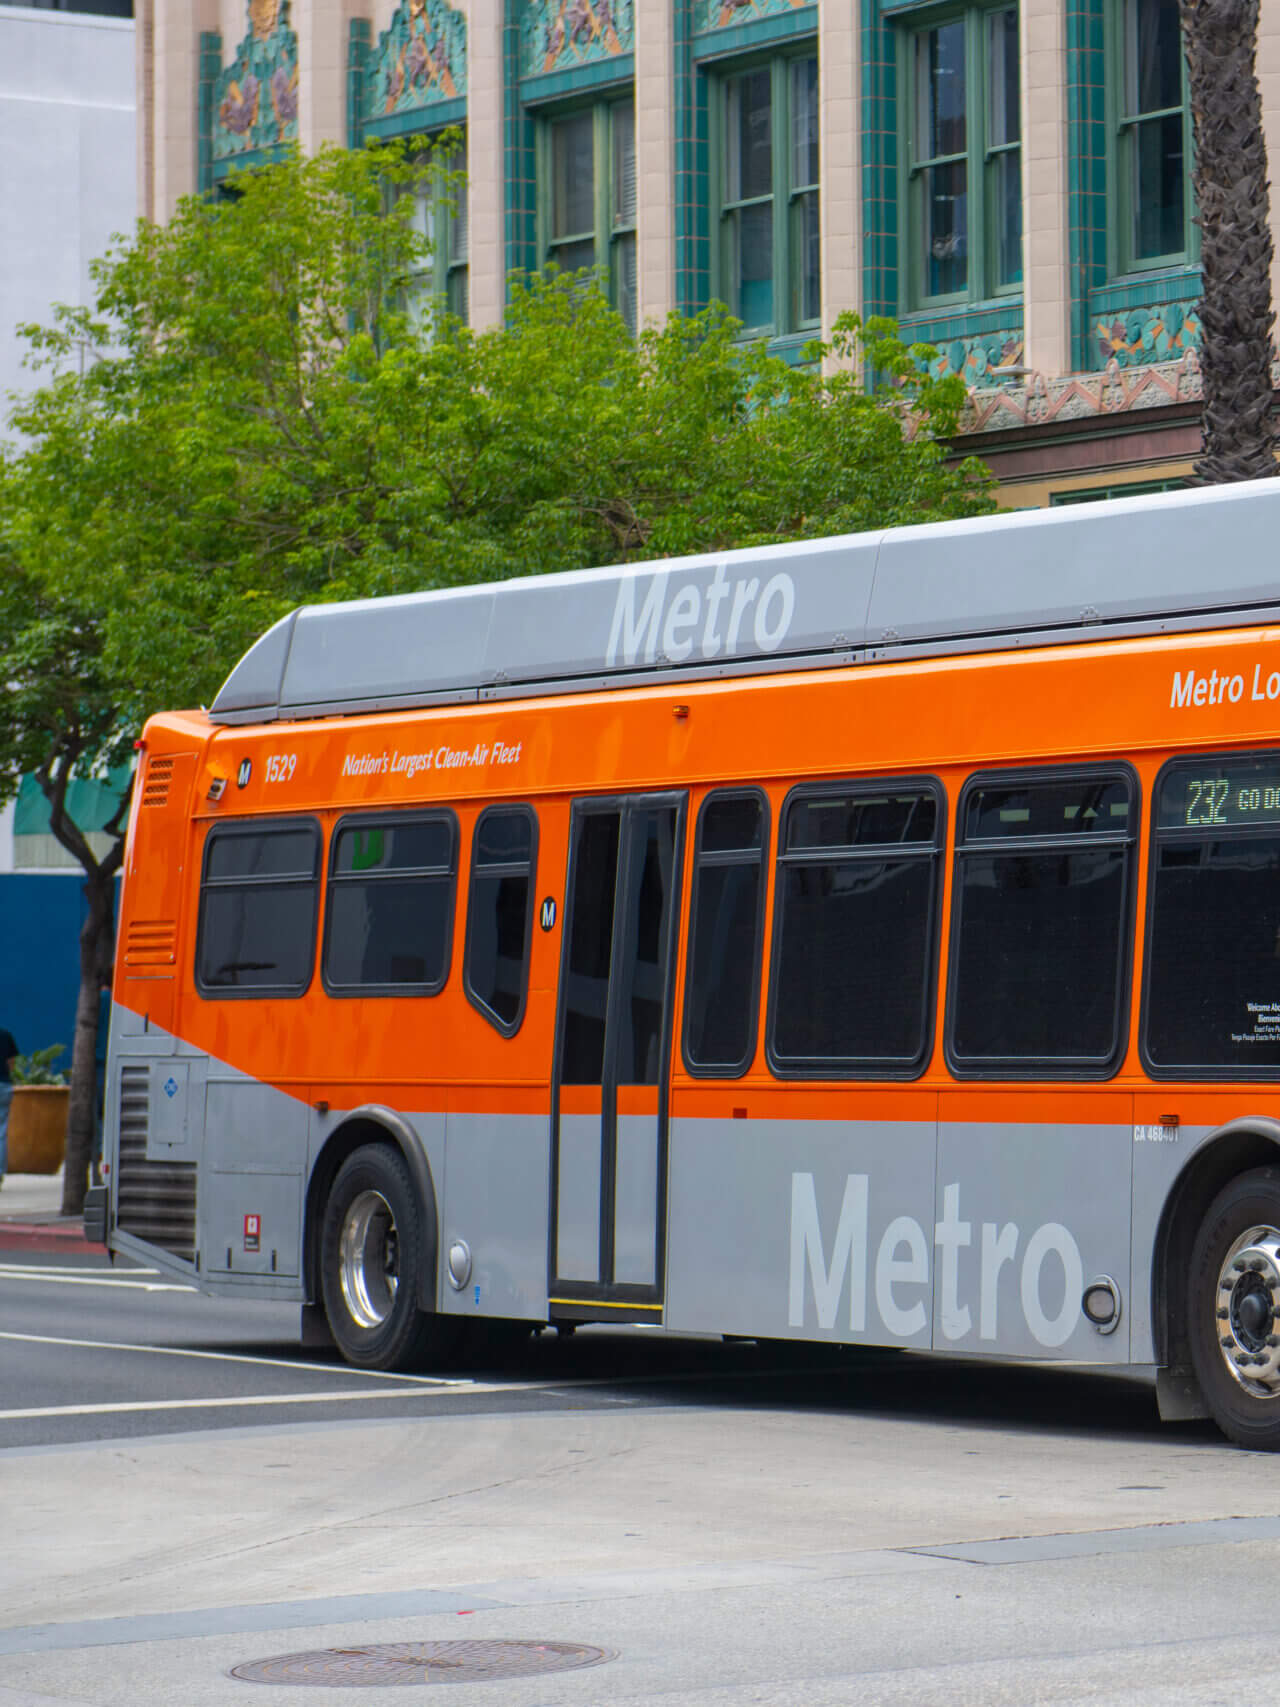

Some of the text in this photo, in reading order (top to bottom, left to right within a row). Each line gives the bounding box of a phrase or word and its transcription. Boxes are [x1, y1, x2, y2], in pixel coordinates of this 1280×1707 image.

[605, 560, 796, 668] Metro
[1169, 669, 1244, 708] Metro
[264, 753, 297, 783] 1529
[341, 741, 523, 779] Nation's Largest Clean-Air Fleet
[1185, 779, 1231, 825] 232
[1238, 789, 1260, 810] GO
[1134, 1125, 1146, 1142] CA
[788, 1172, 1084, 1348] Metro
